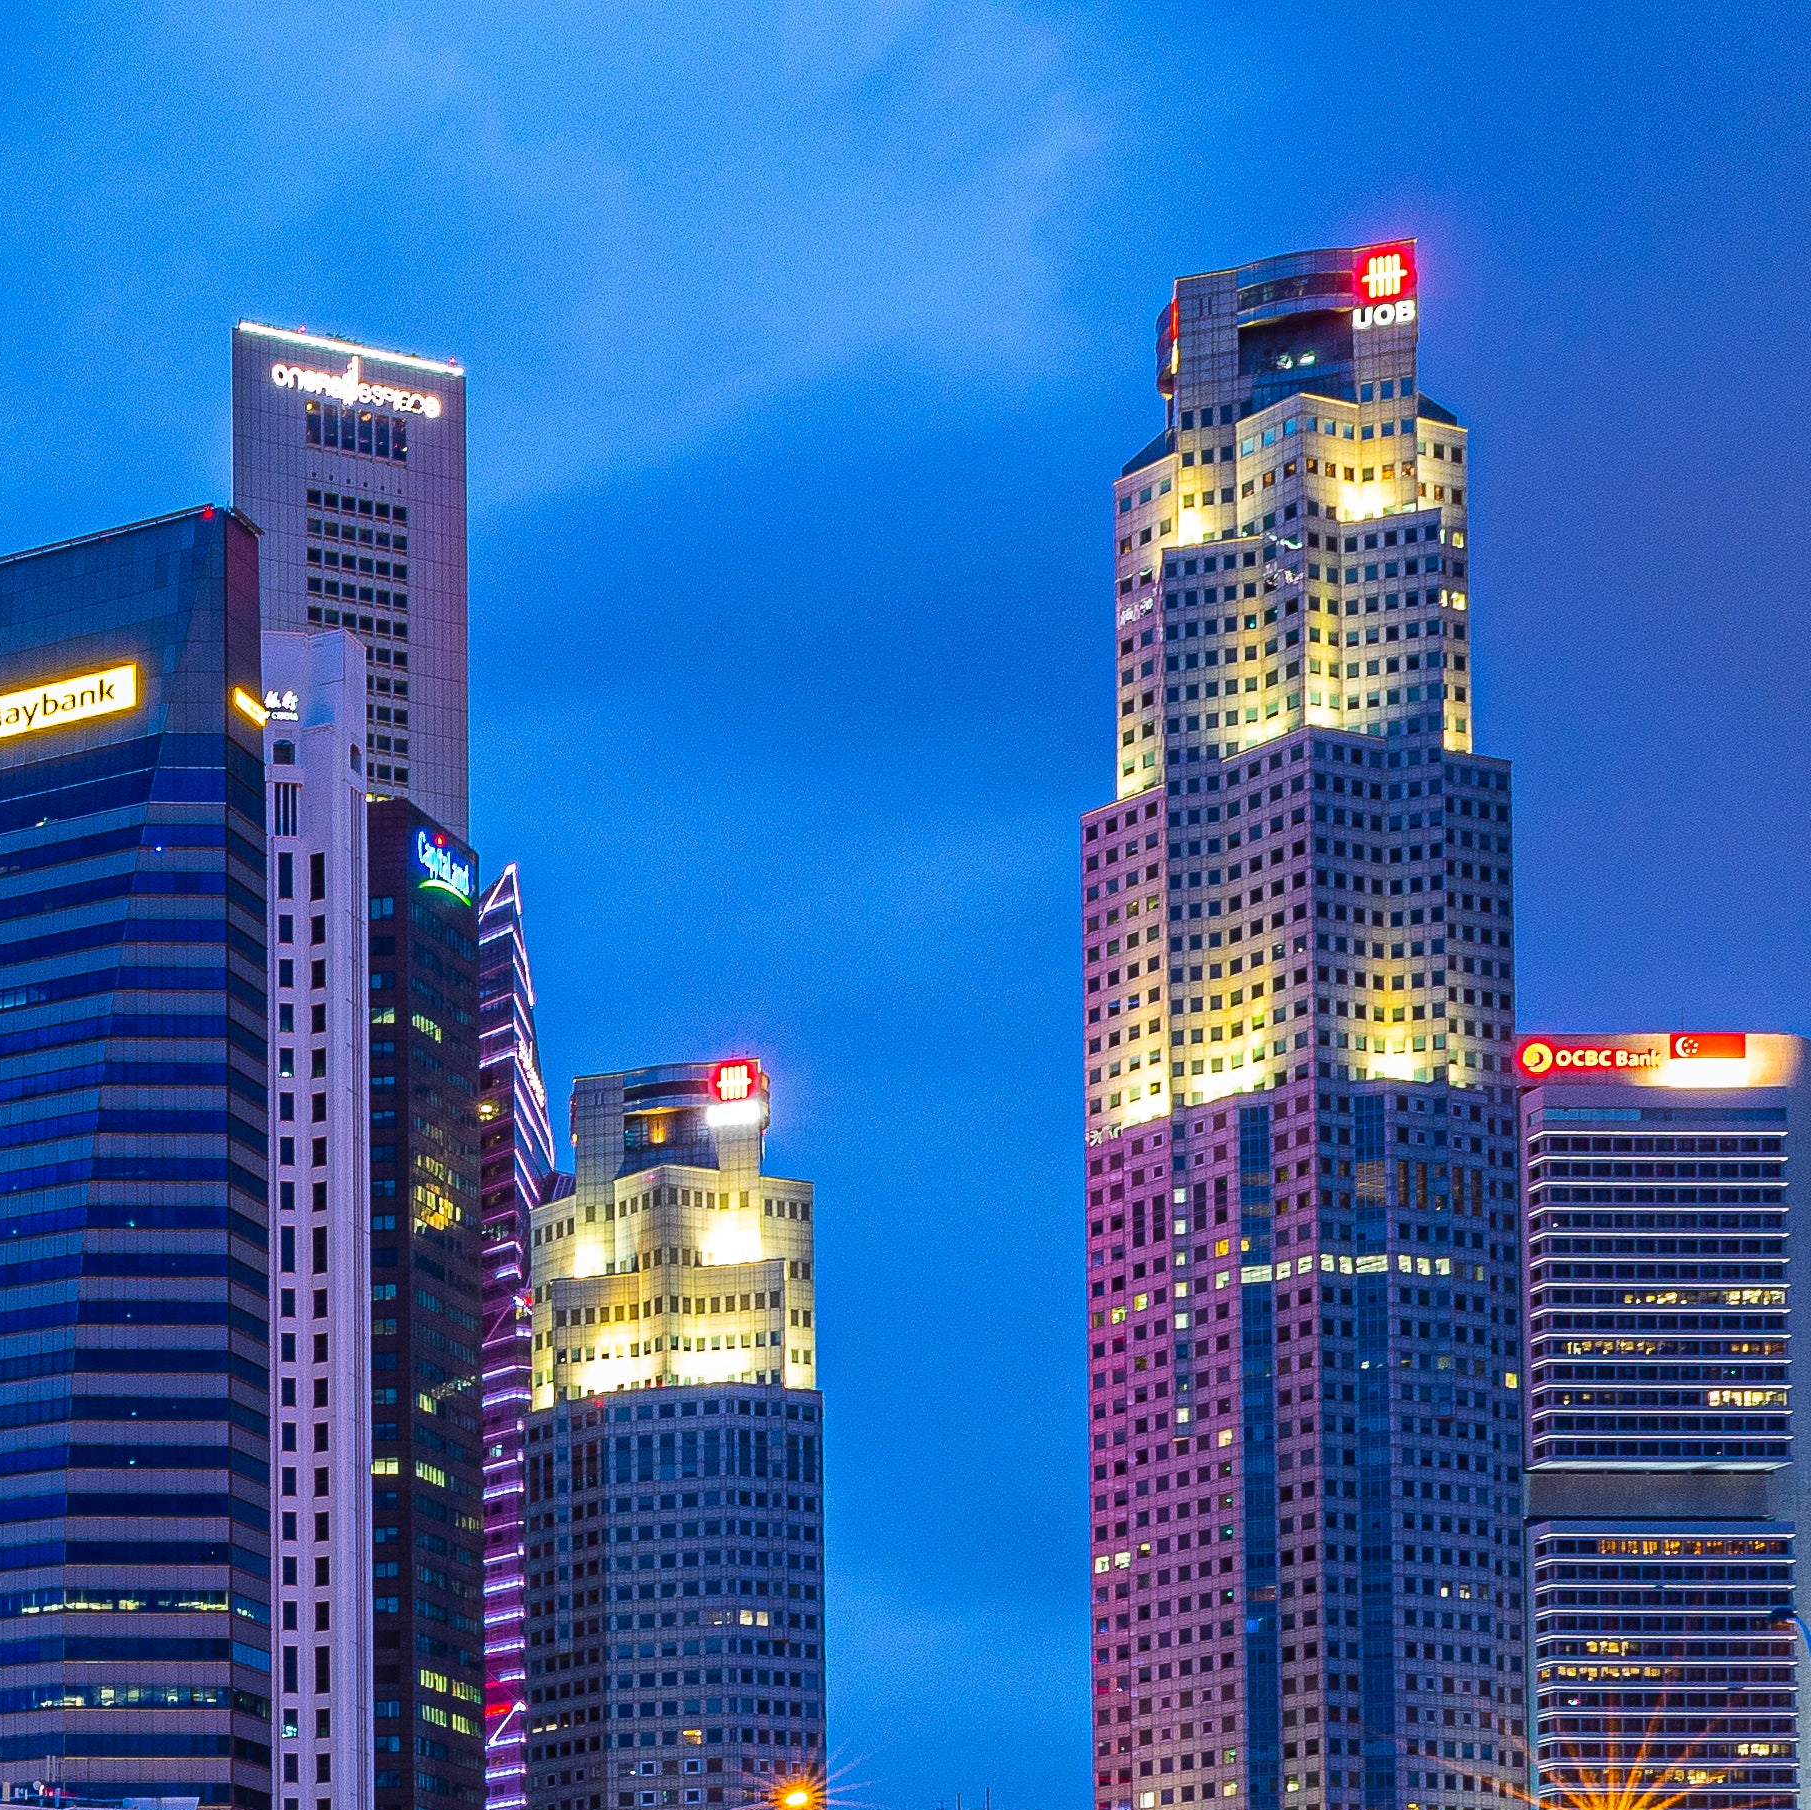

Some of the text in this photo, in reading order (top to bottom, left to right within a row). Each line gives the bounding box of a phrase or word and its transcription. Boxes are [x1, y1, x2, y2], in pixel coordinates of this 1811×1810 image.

[1352, 300, 1416, 329] UOB
[1555, 1049, 1662, 1068] OCBC Bank
